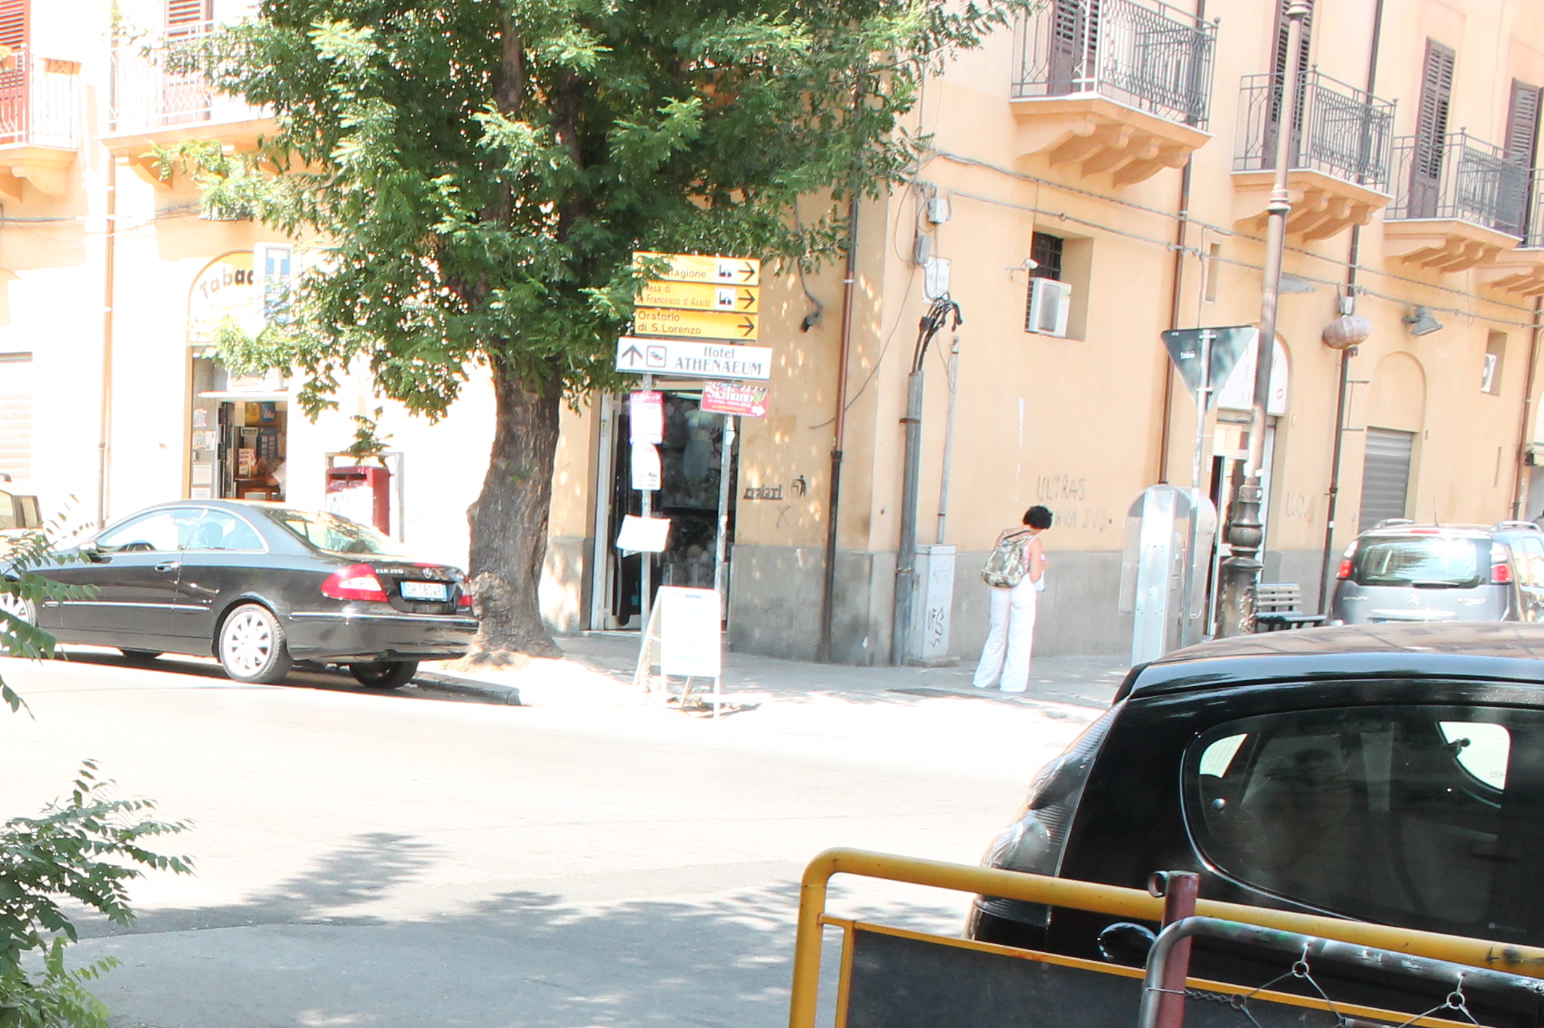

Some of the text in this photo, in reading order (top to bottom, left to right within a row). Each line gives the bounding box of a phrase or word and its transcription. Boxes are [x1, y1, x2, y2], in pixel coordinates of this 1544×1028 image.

[200, 267, 254, 299] Tabac
[638, 311, 680, 322] Oratorio
[638, 322, 647, 331] di
[703, 346, 735, 358] Hotel
[674, 358, 762, 375] ATHENAEUM
